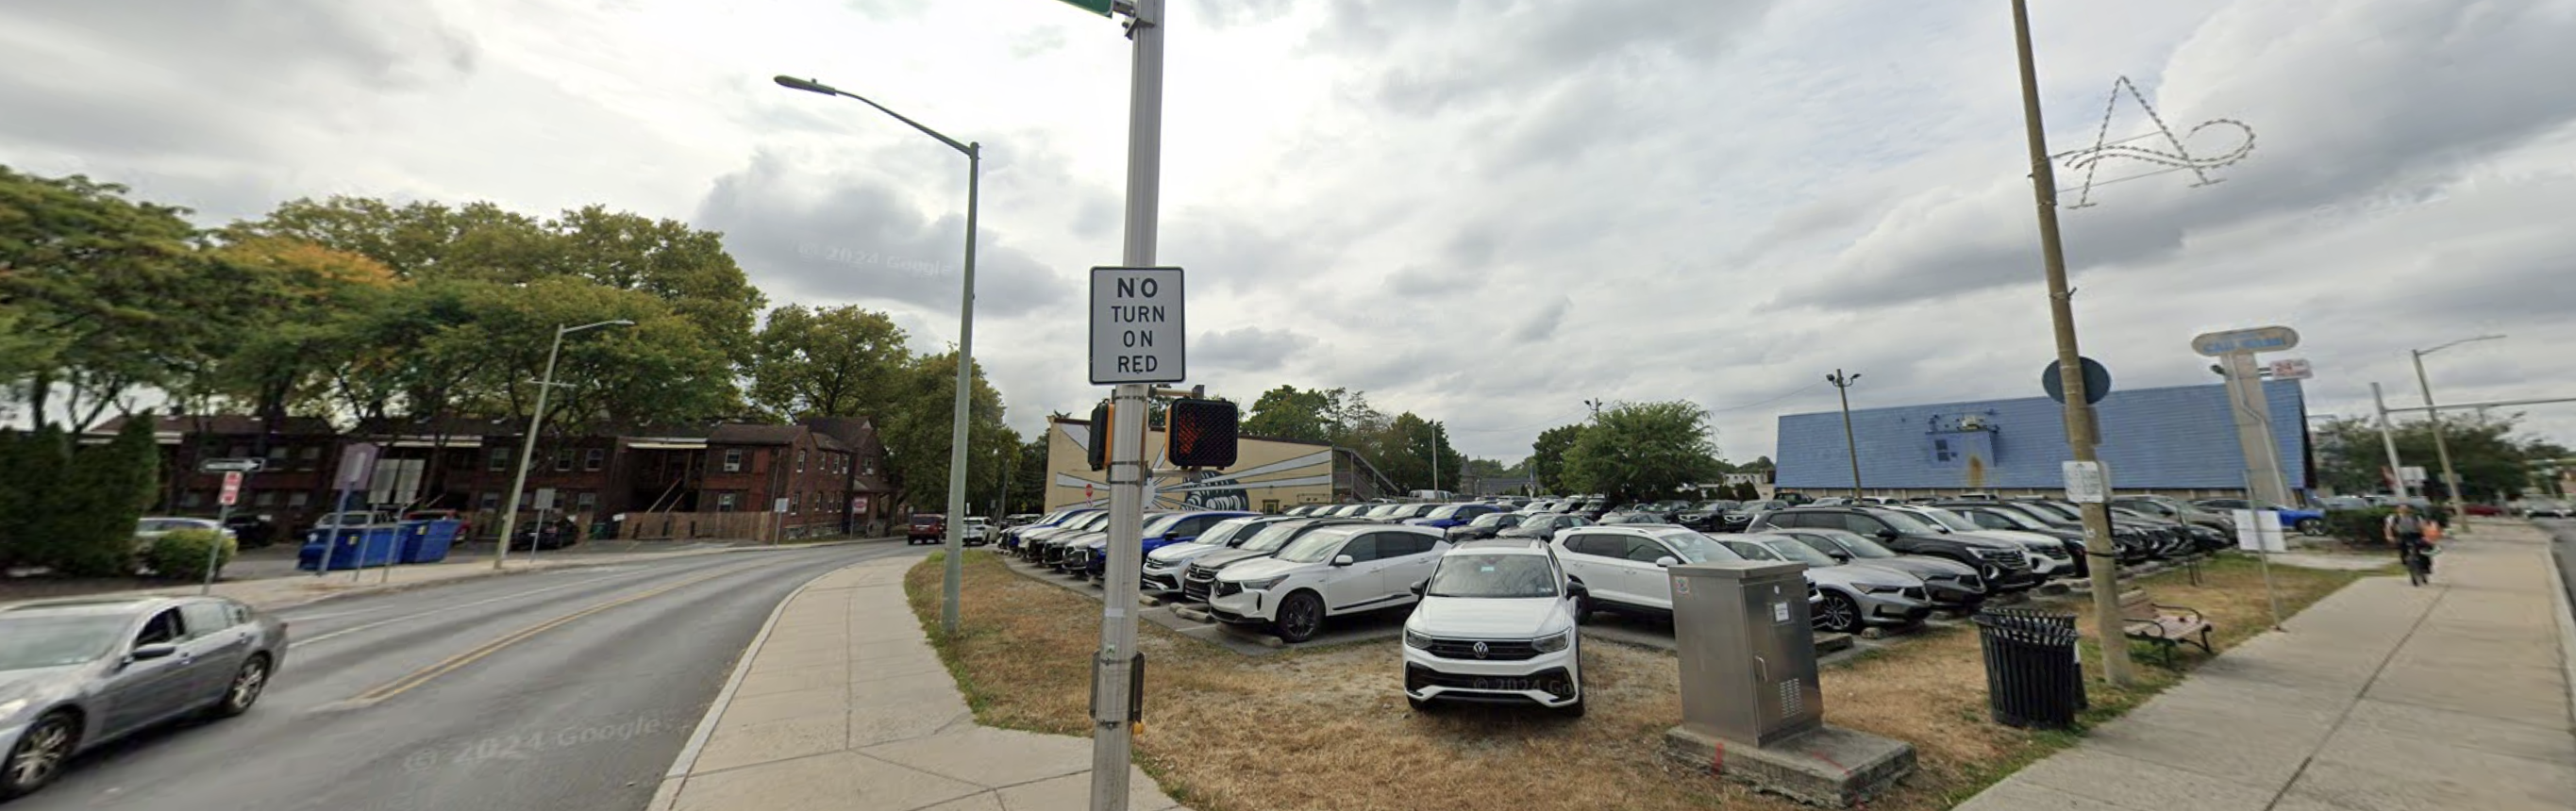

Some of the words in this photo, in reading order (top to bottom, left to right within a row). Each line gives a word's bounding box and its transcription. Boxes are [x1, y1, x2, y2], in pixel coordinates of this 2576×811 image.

[1117, 277, 1158, 298] NO
[1111, 306, 1164, 323] TURN
[1123, 330, 1152, 347] ON
[1117, 356, 1158, 372] RED
